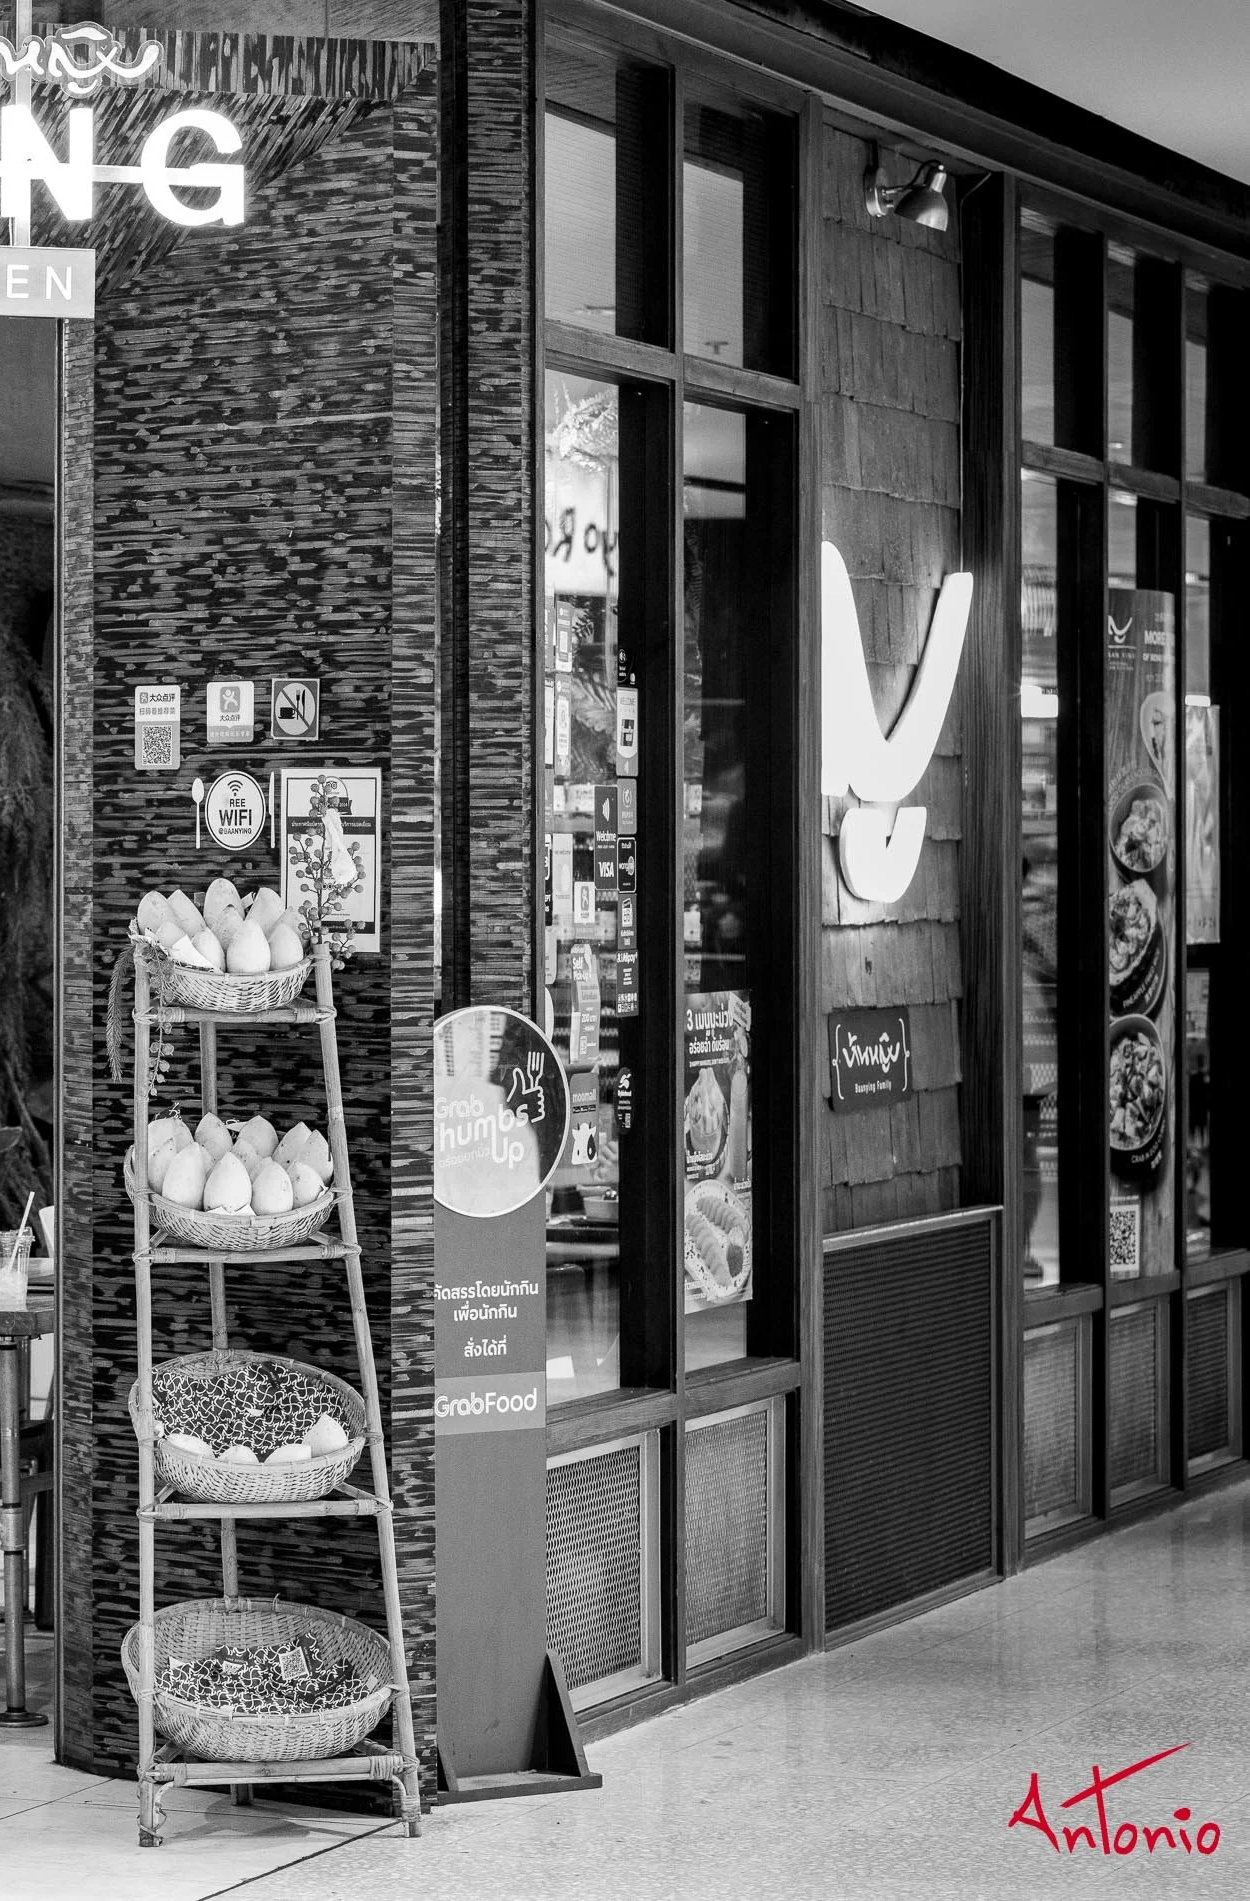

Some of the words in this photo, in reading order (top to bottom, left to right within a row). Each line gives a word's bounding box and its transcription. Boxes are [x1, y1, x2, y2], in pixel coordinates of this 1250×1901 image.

[229, 798, 245, 807] REE
[219, 809, 252, 826] WIFI
[598, 862, 614, 878] VISA
[686, 1009, 693, 1031] 3
[434, 1094, 484, 1118] Grab
[434, 1103, 528, 1153] humbs
[492, 1136, 524, 1169] Up
[453, 1300, 518, 1321] เพื่อนักกิน
[463, 1334, 508, 1357] สั่งได้ที่
[434, 1388, 537, 1417] GrabFood
